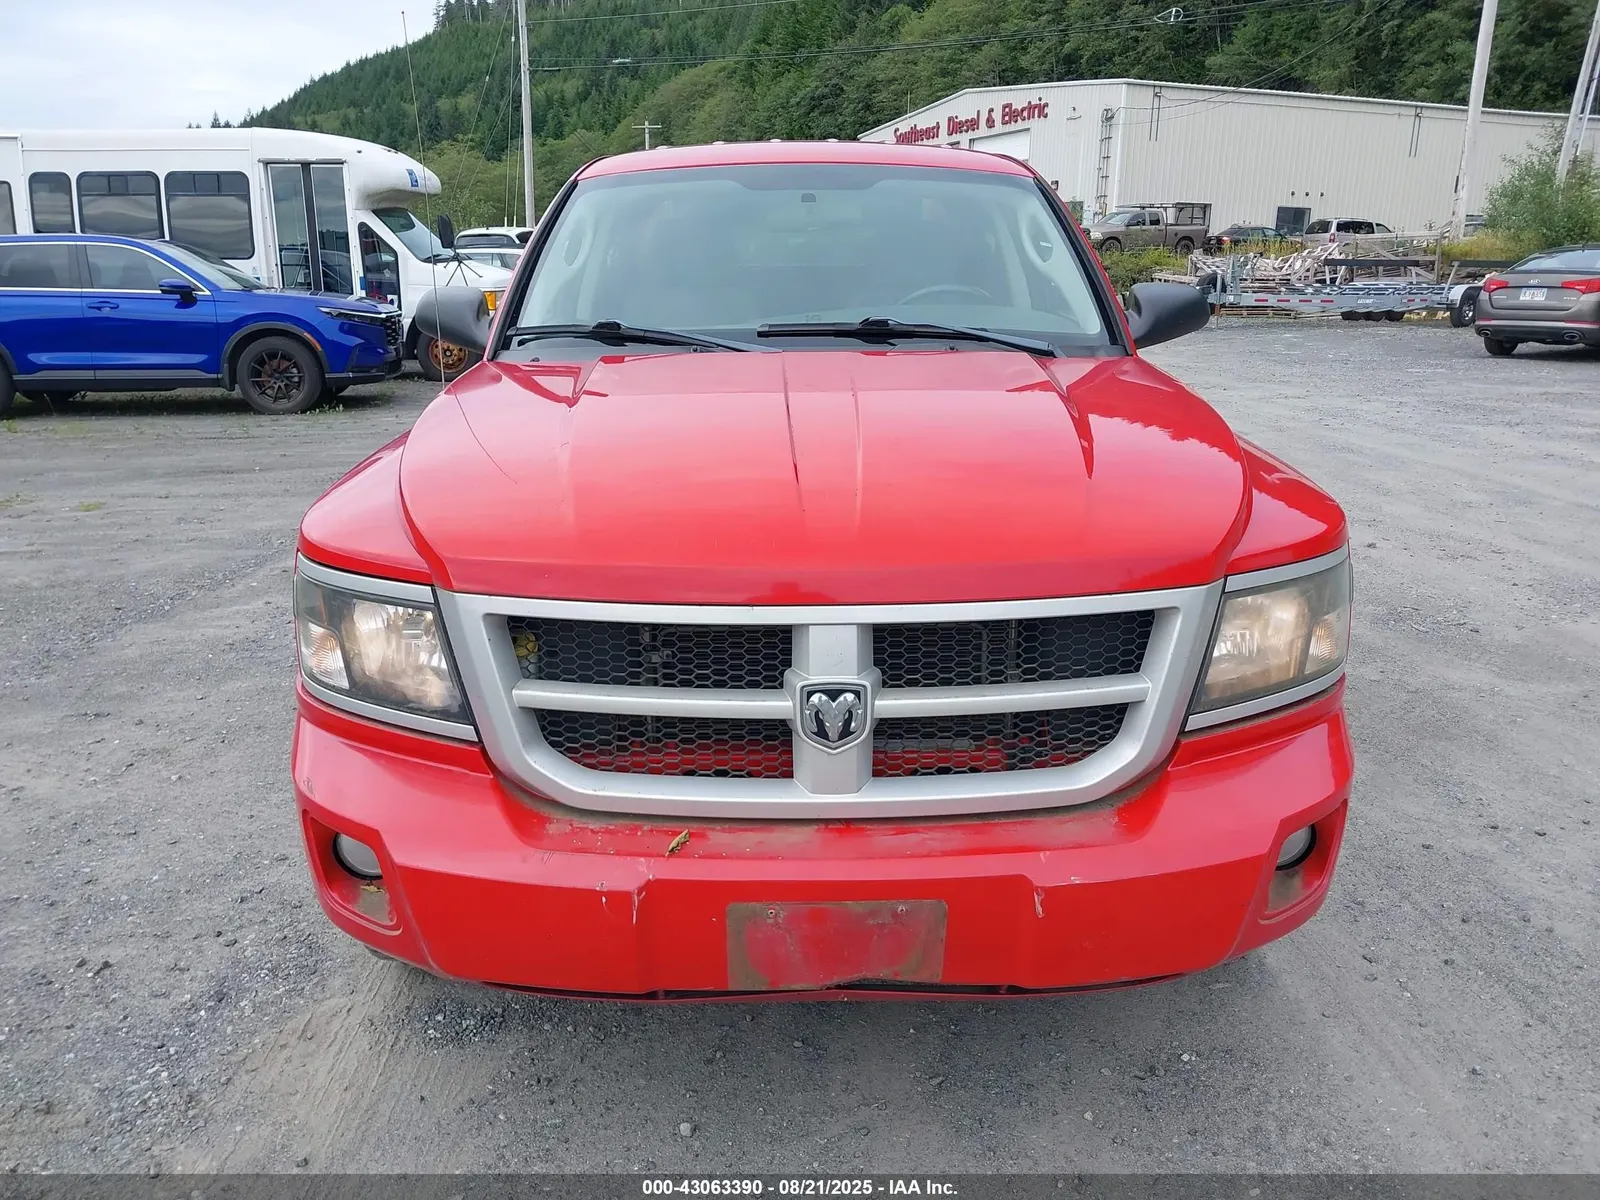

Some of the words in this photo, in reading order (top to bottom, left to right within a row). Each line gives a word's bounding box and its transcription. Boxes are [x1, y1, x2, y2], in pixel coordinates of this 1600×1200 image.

[894, 120, 940, 143] Southeast
[946, 110, 980, 136] Diesel
[985, 107, 995, 129] &
[1001, 97, 1049, 125] Electric
